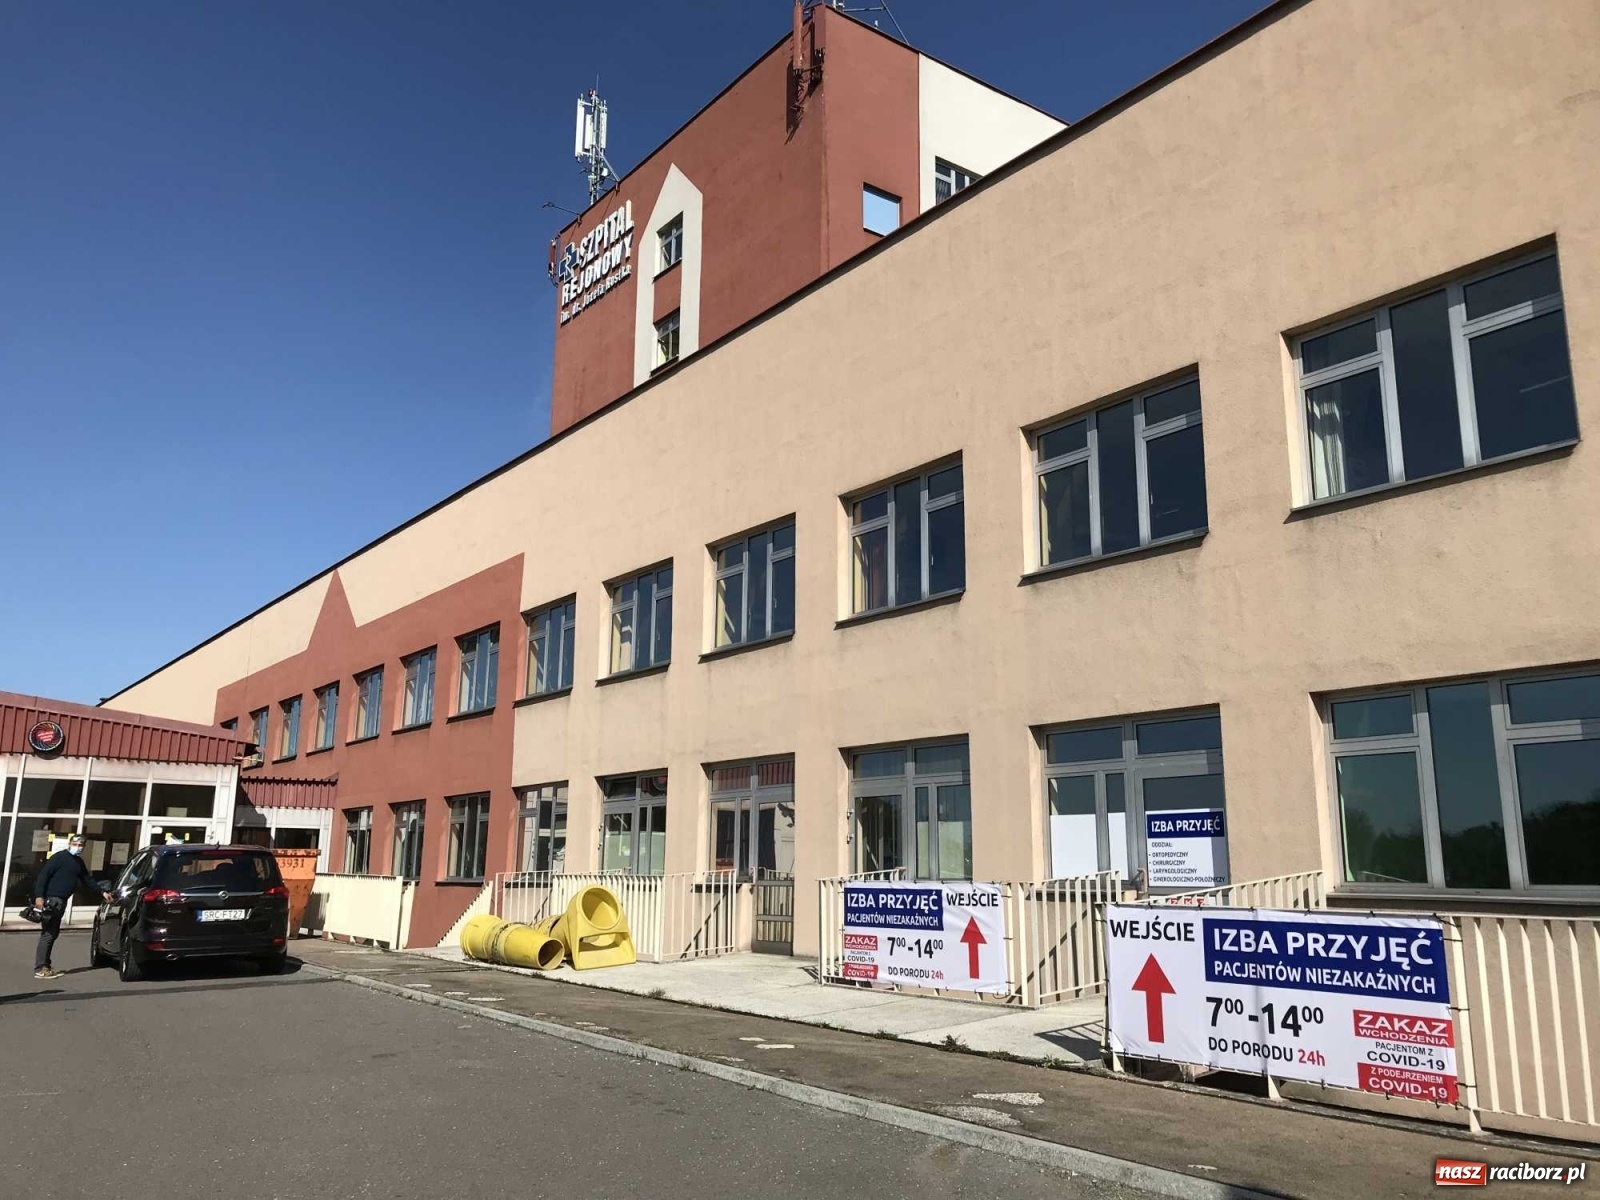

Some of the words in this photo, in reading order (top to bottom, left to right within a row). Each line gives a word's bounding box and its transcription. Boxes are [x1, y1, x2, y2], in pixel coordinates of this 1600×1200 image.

[579, 199, 635, 268] SZPITAL
[562, 233, 633, 306] REJONOWY
[1151, 820, 1175, 832] IZBA
[1176, 815, 1221, 833] PRZYJĘĆ
[847, 893, 876, 908] IZBA
[879, 891, 939, 914] PRZYJĘĆ
[946, 889, 999, 907] WEJŚCIE
[847, 911, 886, 924] PACJENTÓW
[886, 913, 939, 927] NIEZAKAŹNYCH
[1110, 916, 1195, 942] WEJŚCIE
[845, 935, 877, 946] ZAKAZ
[1214, 928, 1279, 955] IZBA
[1286, 931, 1434, 971] PRZYJĘĆ
[847, 955, 875, 963] COVID-19
[847, 969, 875, 978] COVID-19
[888, 966, 899, 976] DO
[899, 968, 930, 978] PORODU
[931, 970, 944, 980] 24h
[1214, 960, 1302, 982] PACJENTÓW
[1305, 967, 1436, 995] NIEZAKAŹNYCH
[1358, 1013, 1449, 1038] ZAKAZ
[1358, 1028, 1450, 1046] WCHODZENIA
[1208, 1036, 1228, 1052] DO
[1232, 1039, 1293, 1062] PORODU
[1297, 1048, 1326, 1067] 24h
[1375, 1041, 1426, 1055] PACJENTOM
[1428, 1048, 1434, 1056] Z
[1367, 1050, 1446, 1071] COVID-19
[1370, 1066, 1377, 1075] Z
[1377, 1067, 1444, 1084] PODEJRZENIEM
[1368, 1077, 1448, 1099] COVID-19
